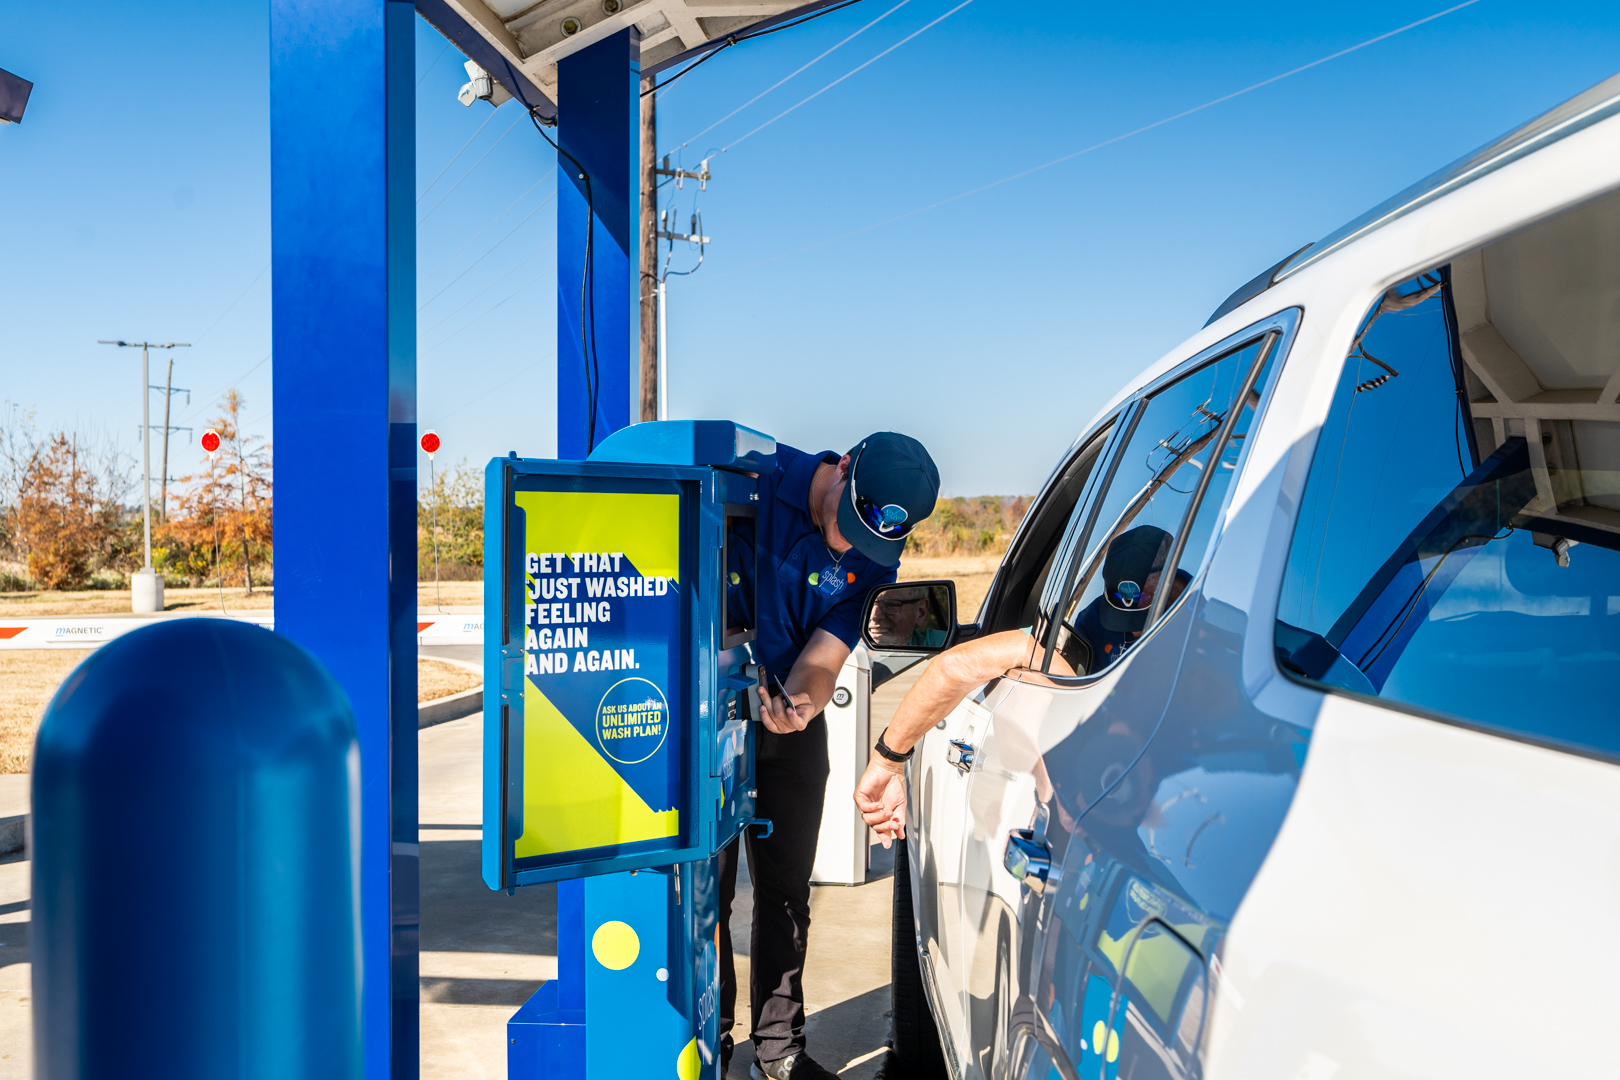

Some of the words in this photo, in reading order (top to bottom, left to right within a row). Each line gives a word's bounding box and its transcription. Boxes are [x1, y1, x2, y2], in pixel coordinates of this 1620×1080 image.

[525, 552, 566, 574] GET
[571, 552, 624, 573] THAT
[525, 601, 611, 625] FEELING
[525, 627, 588, 650] AGAIN
[525, 652, 568, 675] AND
[573, 649, 640, 673] AGAIN.
[602, 705, 617, 714] ASK
[617, 704, 627, 713] US
[628, 702, 651, 712] ABOUT
[652, 702, 662, 710] AN
[602, 711, 661, 727] UNLIMITED
[602, 726, 631, 740] WASH
[633, 724, 661, 737] PLAN!
